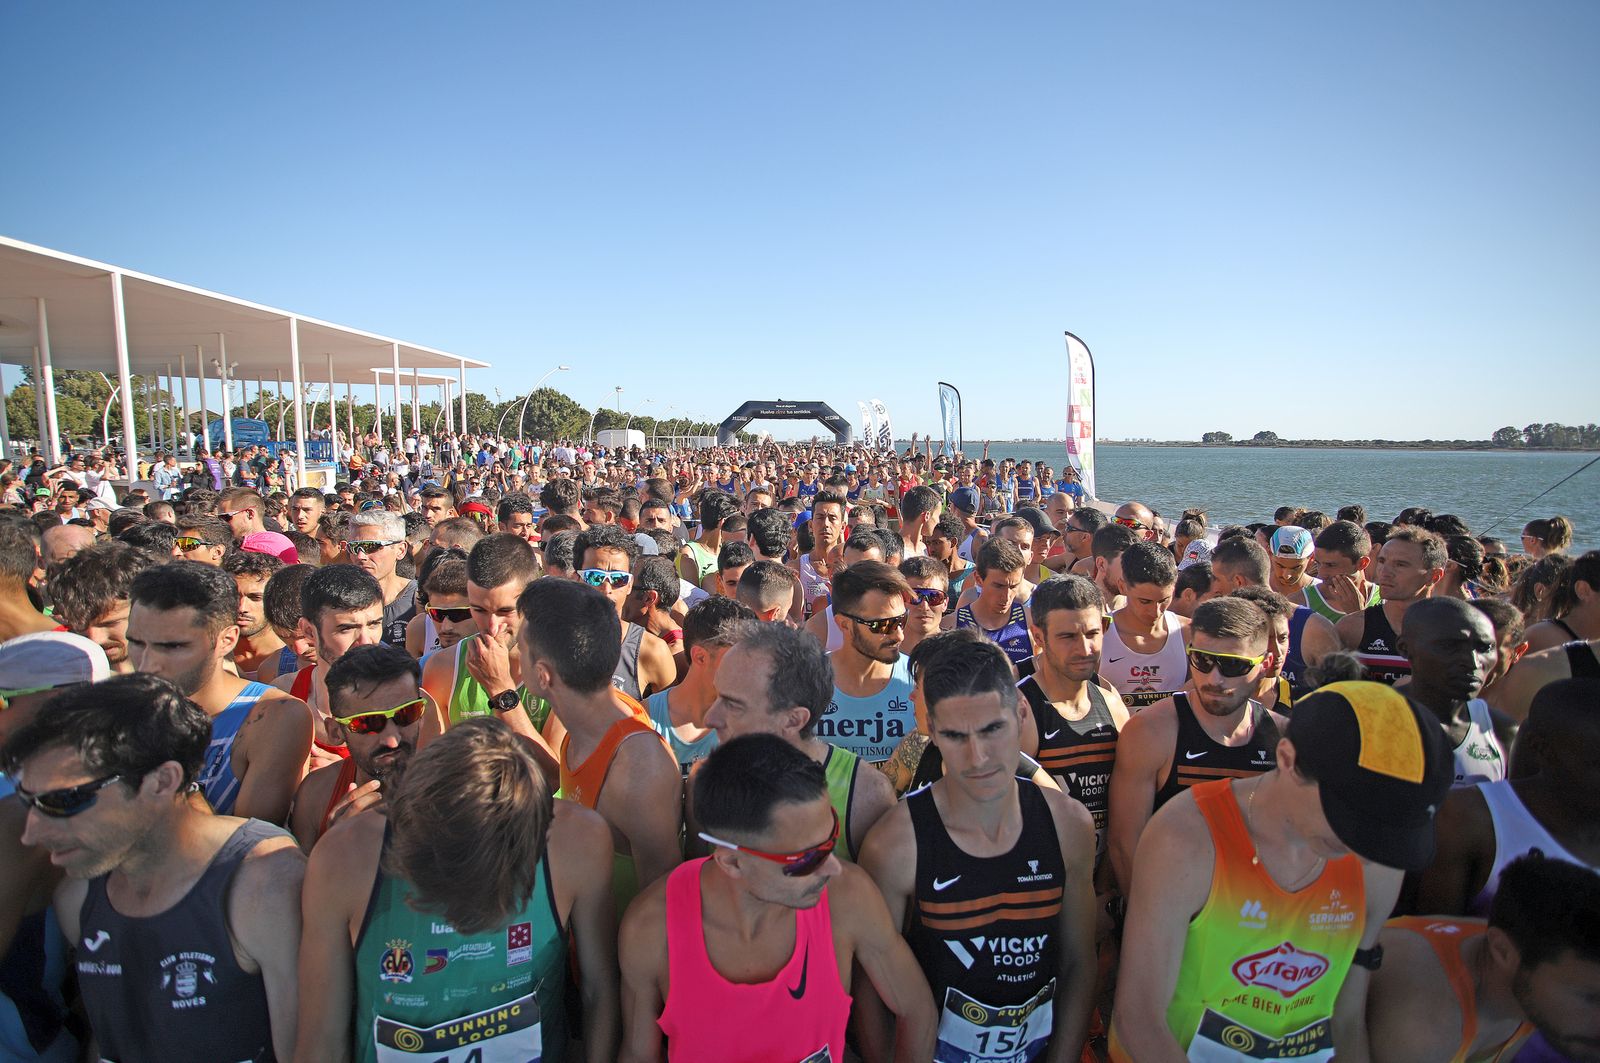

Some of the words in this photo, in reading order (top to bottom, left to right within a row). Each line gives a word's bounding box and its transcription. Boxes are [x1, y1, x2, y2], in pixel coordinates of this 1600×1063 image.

[1130, 665, 1160, 677] CAT
[888, 696, 908, 710] als
[1078, 773, 1111, 787] VICKY
[1309, 912, 1354, 925] SERRANO
[989, 934, 1048, 953] VICKY
[160, 954, 176, 967] CLUB
[179, 952, 215, 964] ATLETISMO
[993, 952, 1041, 967] FOODS
[1252, 997, 1281, 1015] BIEN
[435, 1005, 522, 1040] RUNNING
[458, 1024, 508, 1046] LOOP
[976, 1022, 1028, 1054] 152
[1279, 1042, 1317, 1058] LOOP
